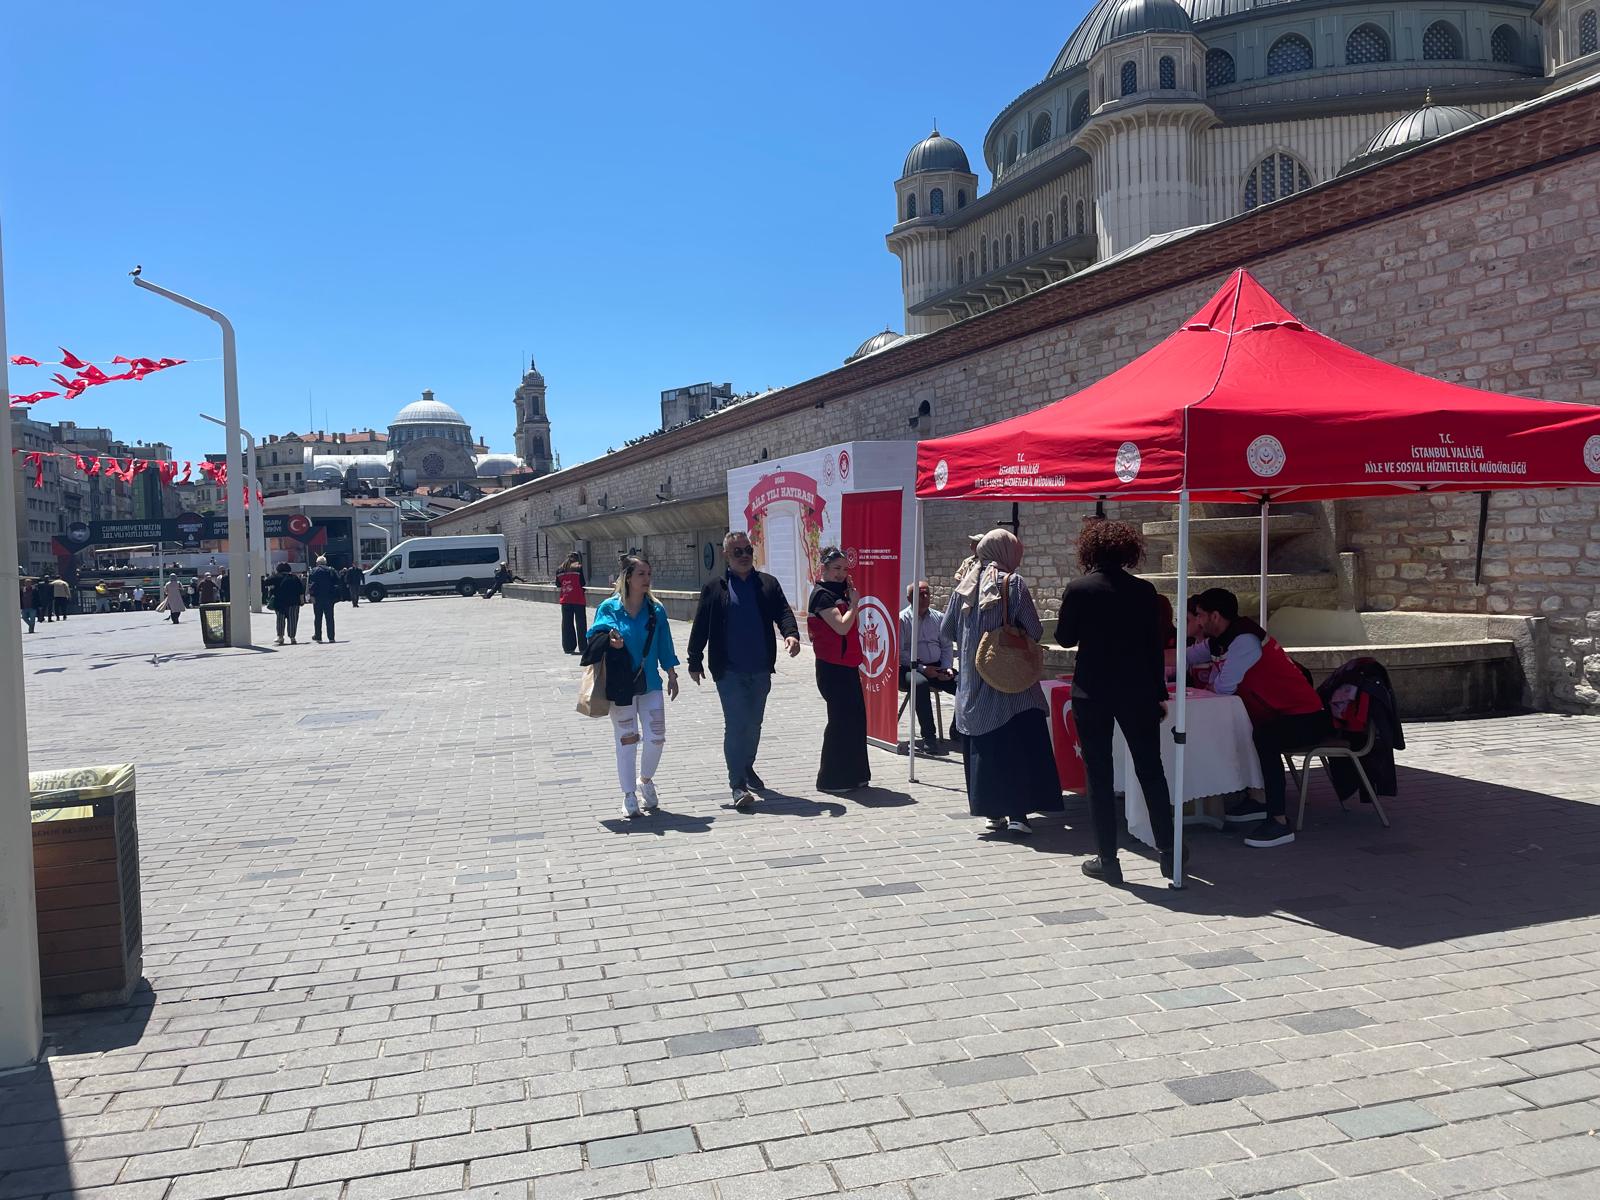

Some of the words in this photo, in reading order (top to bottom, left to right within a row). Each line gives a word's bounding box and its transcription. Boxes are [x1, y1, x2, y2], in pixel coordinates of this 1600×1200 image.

[1438, 433, 1455, 443] T.C.
[1411, 445, 1450, 458] İSTANBUL
[1451, 445, 1485, 458] VALİLİĞİ
[1365, 461, 1383, 473] AİLE
[1384, 462, 1395, 473] VE
[1396, 462, 1425, 473] SOSYAL
[1426, 460, 1470, 473] HİZMETLER
[1471, 460, 1479, 473] İL
[1480, 461, 1527, 474] MÜDÜRLÜĞÜ
